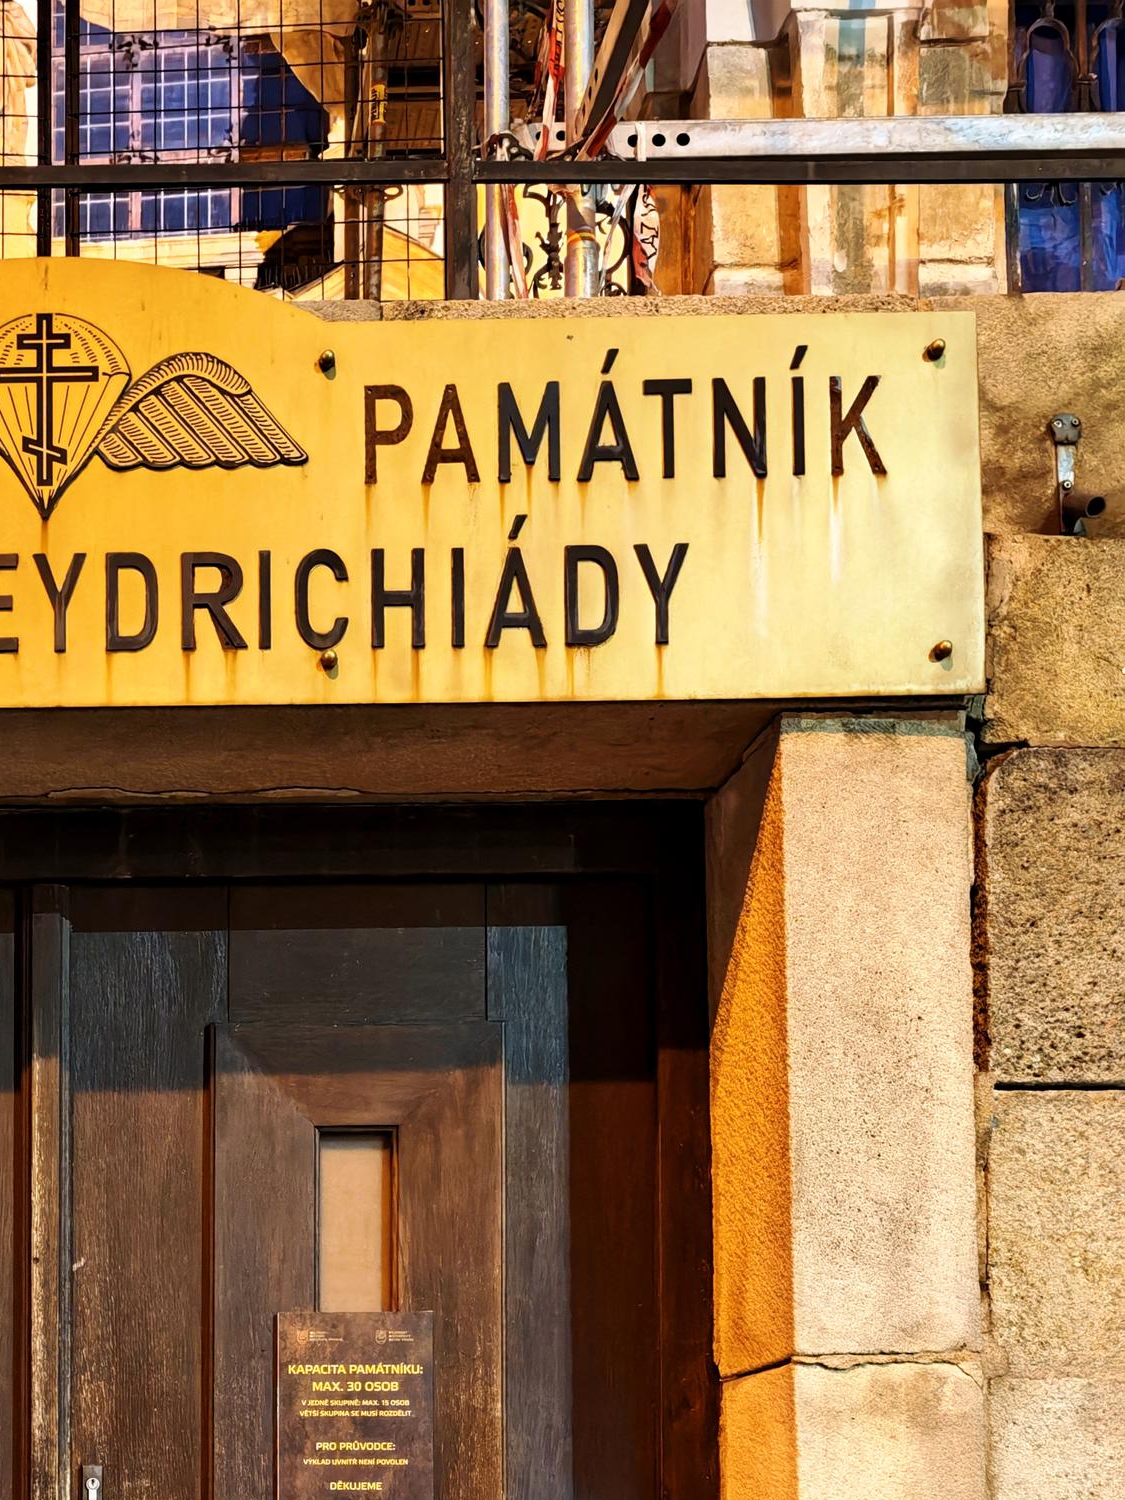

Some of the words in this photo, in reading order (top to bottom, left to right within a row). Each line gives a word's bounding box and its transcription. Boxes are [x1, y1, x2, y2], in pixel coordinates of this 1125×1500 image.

[363, 345, 888, 485] PAMÁTNÍK
[288, 1364, 346, 1375] KAPACITA
[349, 1362, 423, 1375] PAMÁTNÍKU:
[312, 1381, 344, 1392] MAX.
[347, 1381, 361, 1392] 30
[364, 1381, 399, 1392] OSOB
[299, 1409, 319, 1417] VĚTŠÍ
[361, 1409, 378, 1417] MUSÍ
[316, 1442, 337, 1451] PRO
[340, 1440, 396, 1451] PRŮVODCE:
[303, 1457, 331, 1466] VÝKLAD
[332, 1457, 358, 1466] UVNITŘ
[359, 1457, 375, 1466] NENÍ
[376, 1458, 409, 1466] POVOLEN
[330, 1480, 383, 1491] DĚKUJEME
